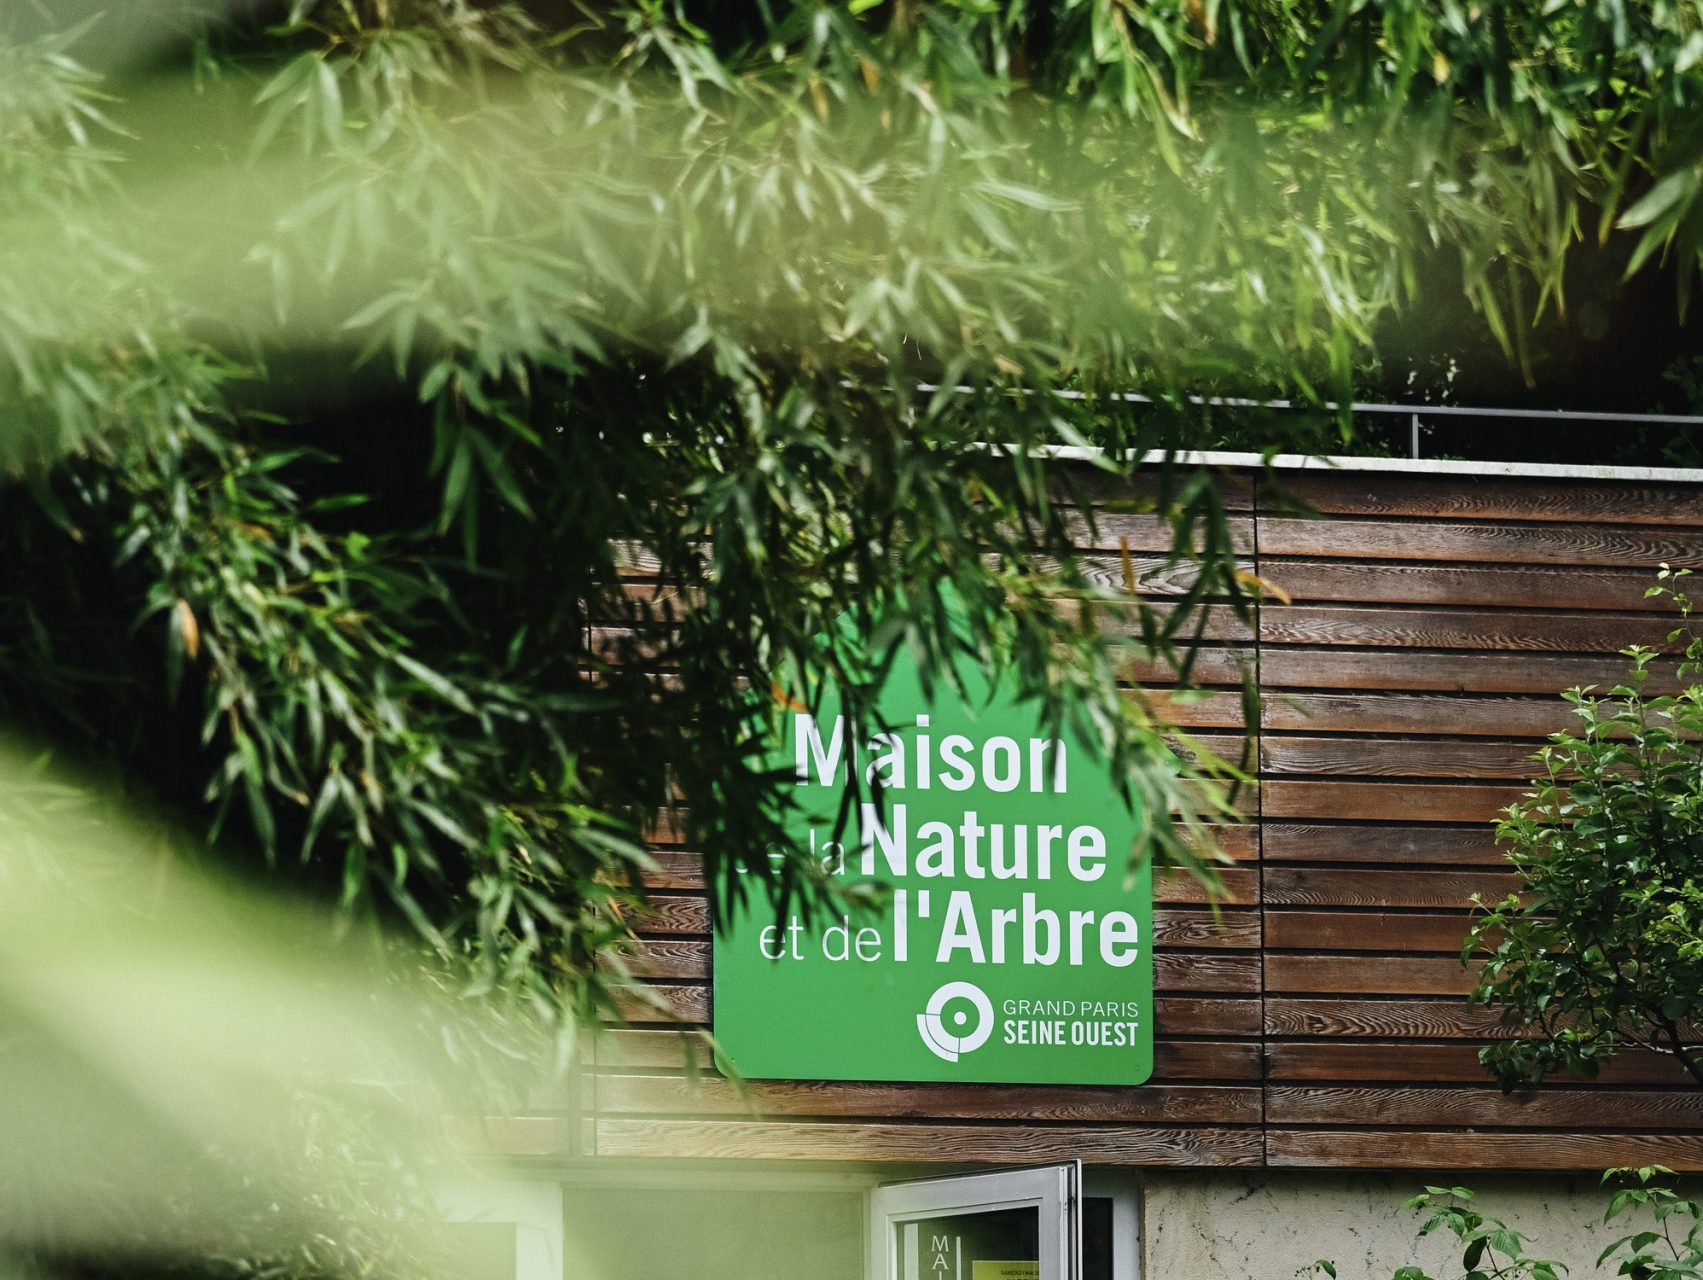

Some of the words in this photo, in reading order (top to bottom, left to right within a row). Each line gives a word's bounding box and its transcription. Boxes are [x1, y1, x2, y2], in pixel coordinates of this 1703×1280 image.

[794, 713, 1067, 793] Maison
[809, 829, 845, 877] la
[861, 803, 1107, 880] Nature
[759, 916, 804, 961] et
[823, 915, 882, 962] de
[894, 890, 1139, 968] l'Arbre
[1003, 1000, 1076, 1017] GRAND
[1080, 1001, 1139, 1018] PARIS
[1003, 1020, 1066, 1046] SEINE
[1071, 1021, 1137, 1047] OUEST
